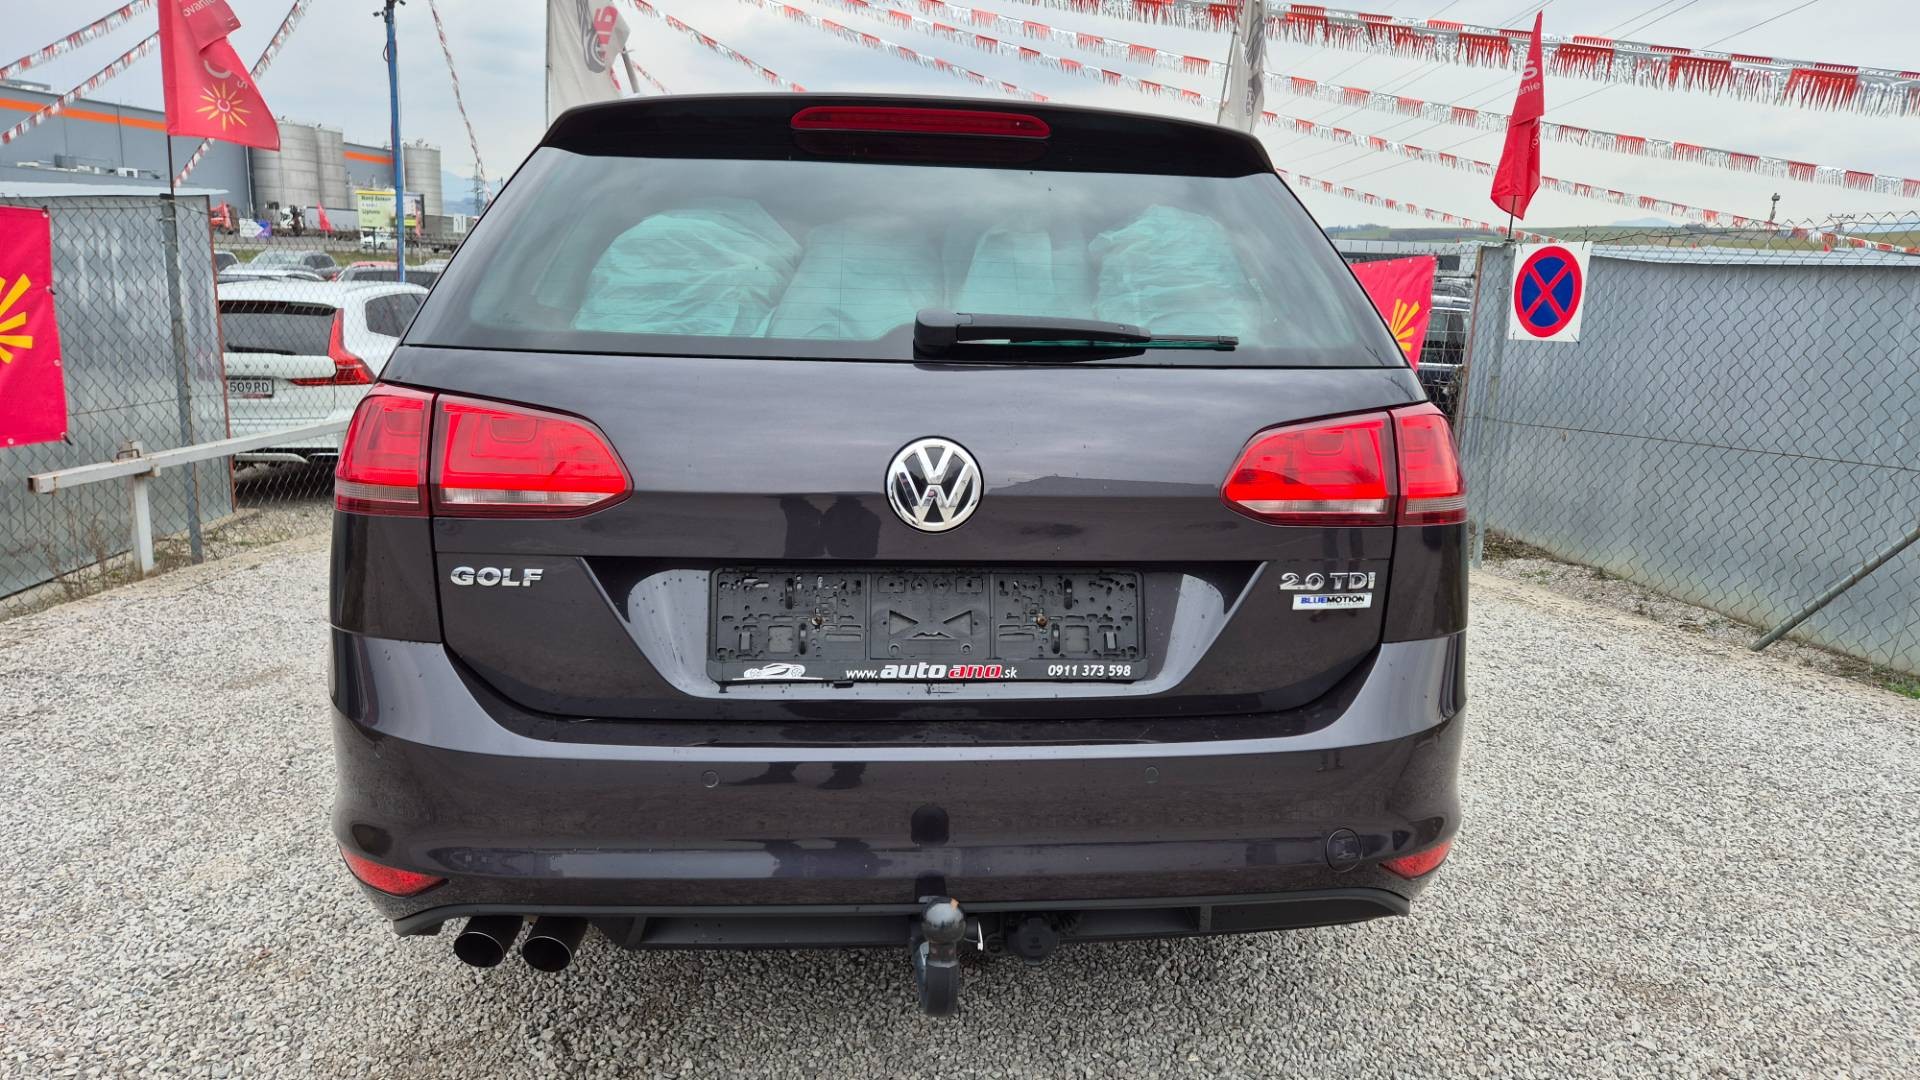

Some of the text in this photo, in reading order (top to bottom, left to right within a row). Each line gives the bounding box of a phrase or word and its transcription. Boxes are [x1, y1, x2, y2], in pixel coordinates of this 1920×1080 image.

[450, 566, 544, 587] GOLF
[1329, 571, 1376, 590] TDI
[1300, 595, 1365, 604] BLUEMOTION
[1047, 664, 1078, 677] 0911
[1081, 664, 1105, 677] 373
[1108, 664, 1131, 677] 598
